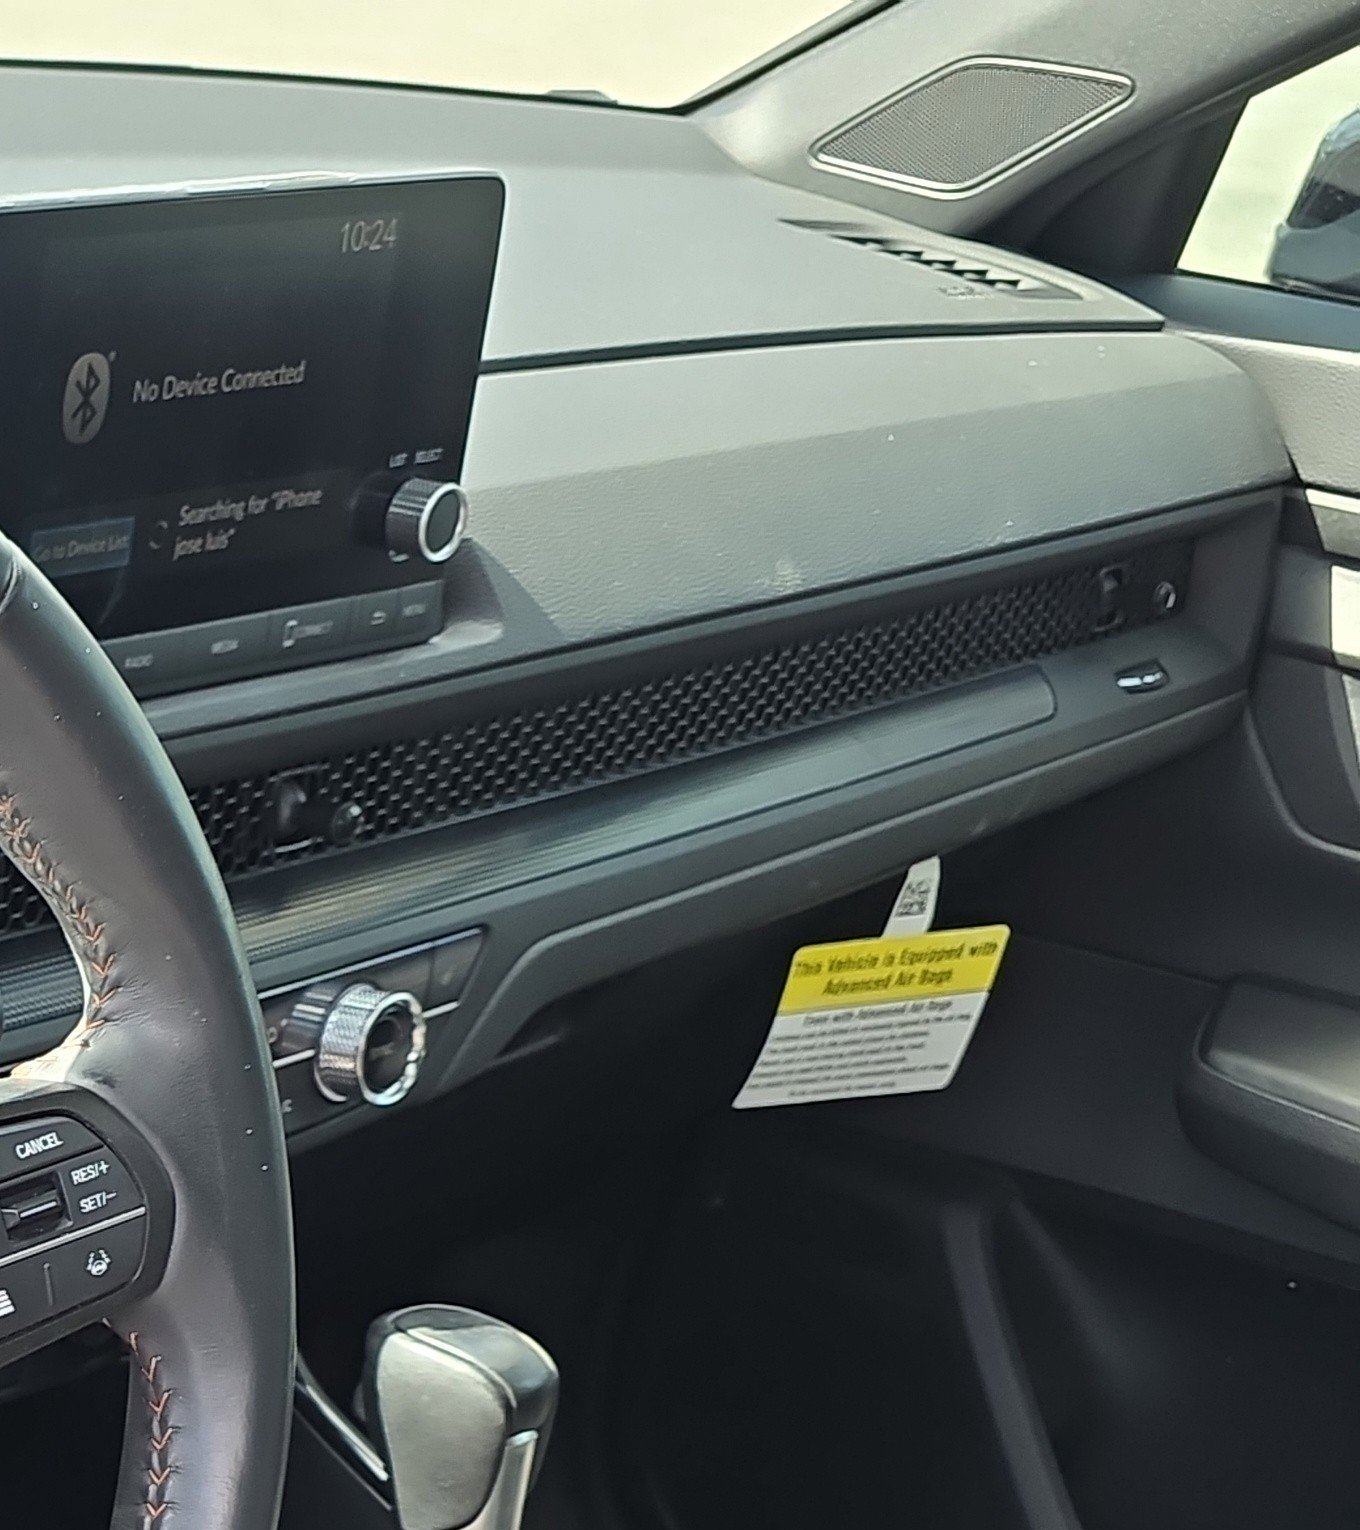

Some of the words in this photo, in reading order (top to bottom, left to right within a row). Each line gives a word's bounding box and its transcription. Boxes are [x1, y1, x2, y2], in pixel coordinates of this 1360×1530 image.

[340, 217, 398, 254] 10:24
[132, 380, 160, 404] No
[161, 371, 219, 398] Device
[220, 360, 306, 391] Connected
[15, 1131, 64, 1159] CANCEL
[70, 1160, 110, 1185] RES/+
